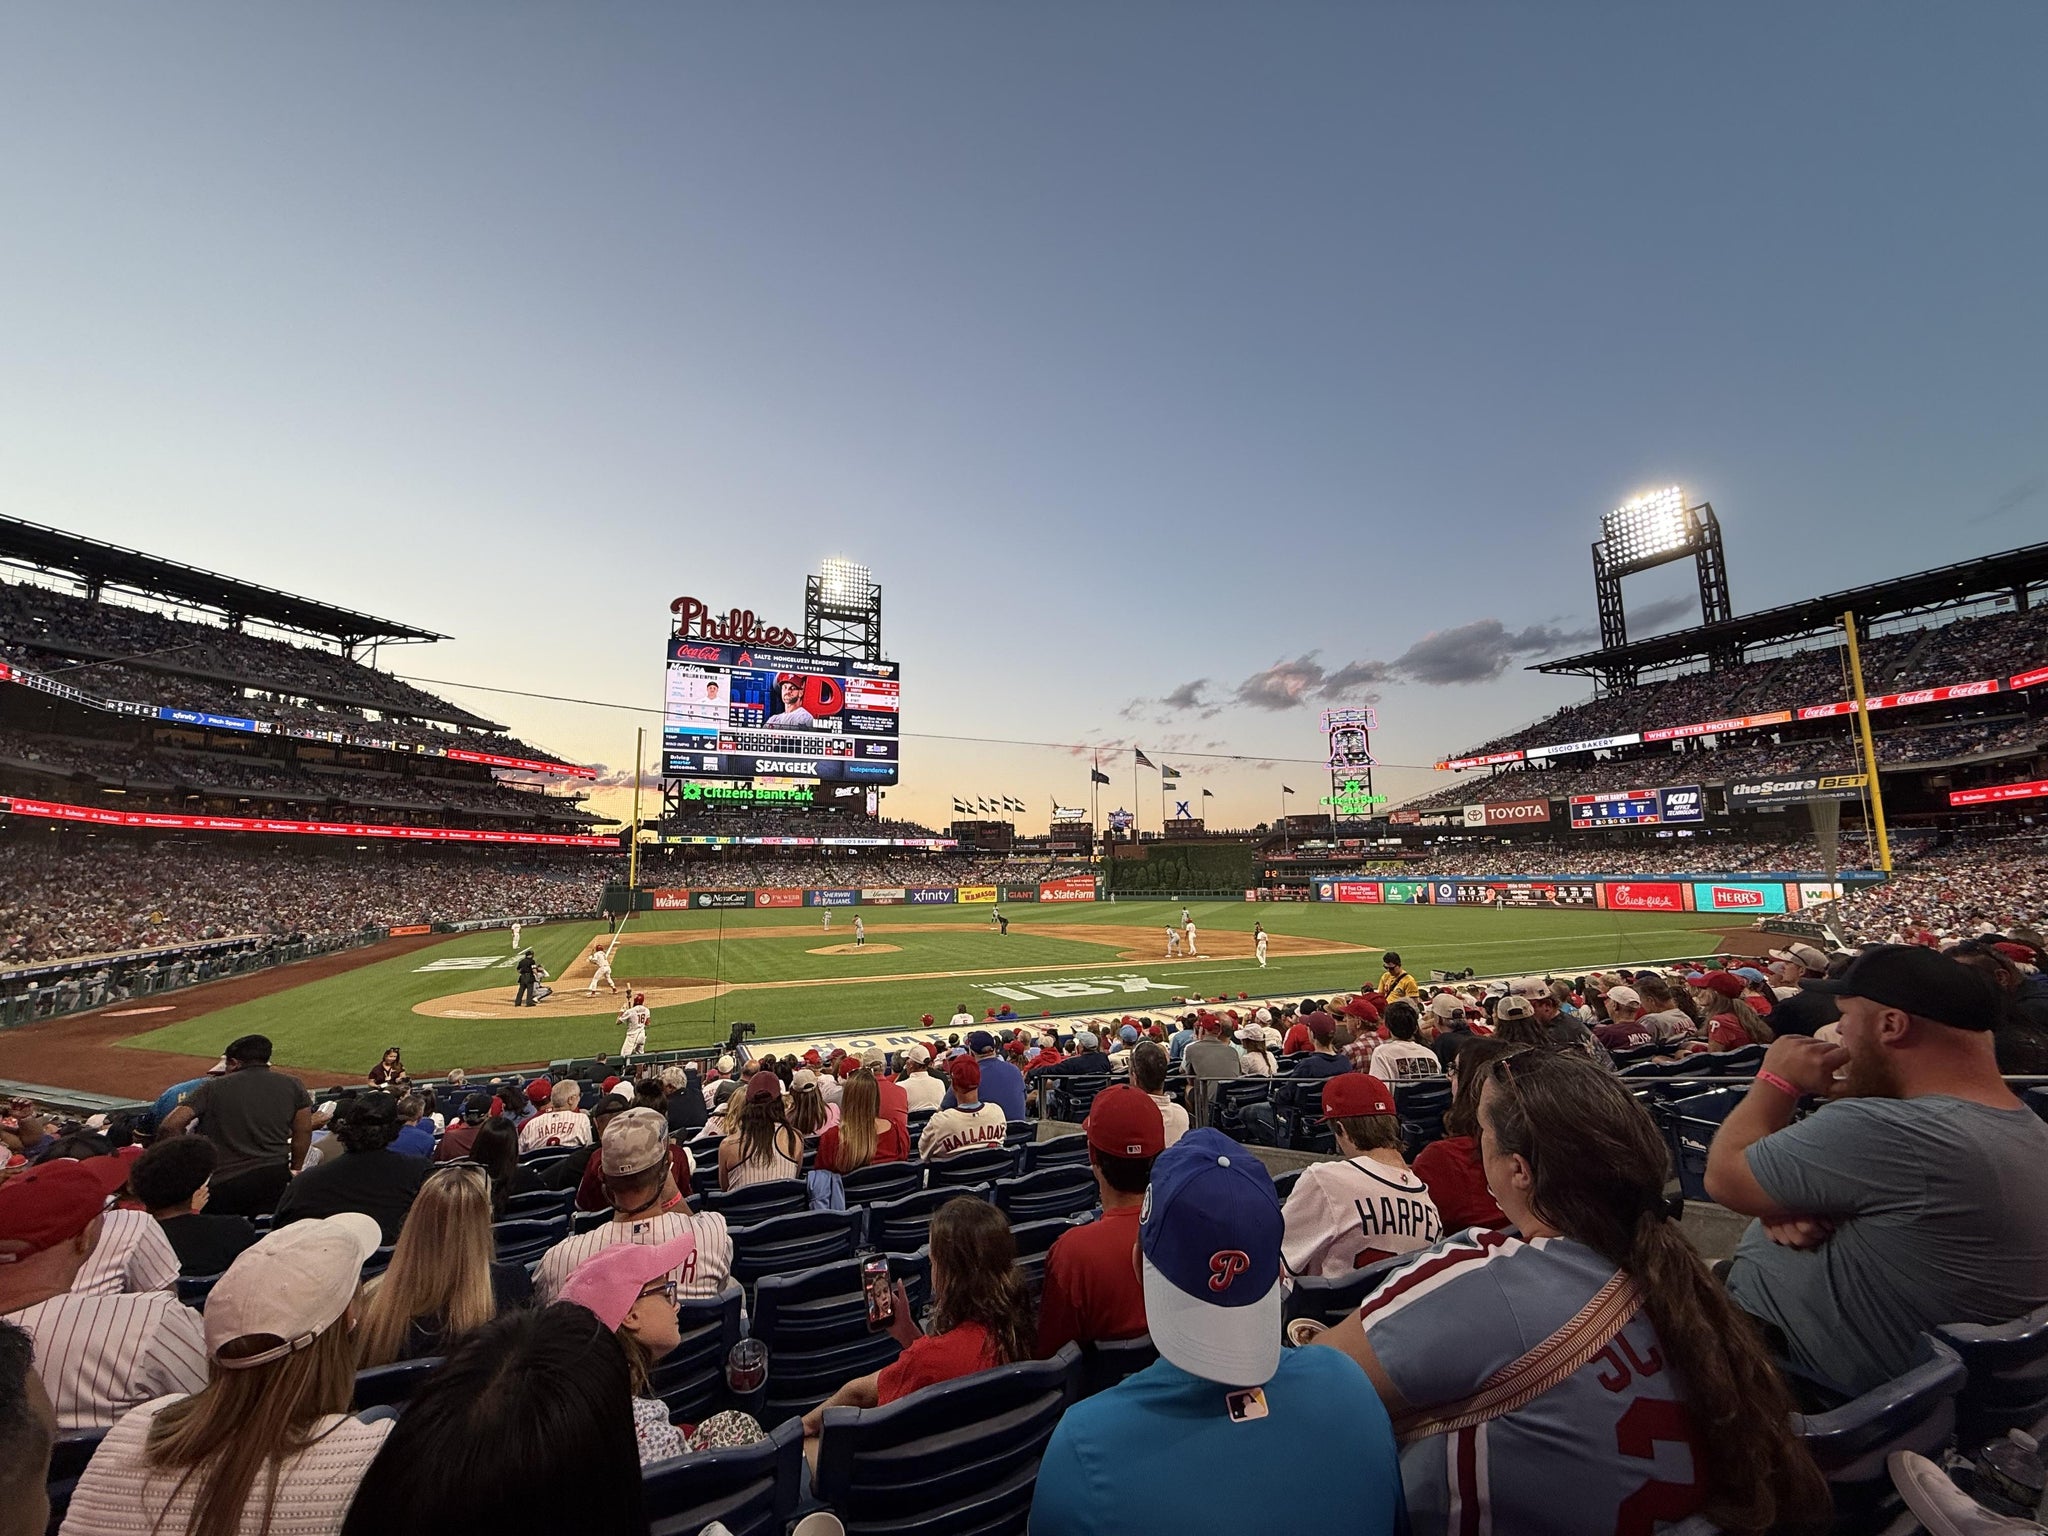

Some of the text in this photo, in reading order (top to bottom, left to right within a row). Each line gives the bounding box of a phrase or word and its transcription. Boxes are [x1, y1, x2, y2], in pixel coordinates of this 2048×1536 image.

[670, 597, 797, 648] Phillies
[669, 663, 706, 673] Marlins
[172, 711, 197, 721] xfinity
[208, 716, 245, 729] Pitch Speed
[812, 718, 843, 729] HARPER
[1648, 720, 1744, 739] WHEY BETTER PROTEIN
[1547, 739, 1614, 754] LISCIO'S BAKERY
[756, 759, 818, 775] SEATGEEK
[1733, 775, 1864, 795] theScore BET
[703, 788, 814, 800] Citizens Bank Park
[1360, 795, 1387, 804] Bank
[1666, 793, 1698, 806] KDI
[1342, 805, 1364, 813] Park
[1487, 805, 1544, 820] TOYOTA
[1666, 808, 1700, 817] TECHNOLOGY
[145, 817, 183, 825] Budweiser
[209, 820, 243, 828] Budweiser
[712, 893, 747, 902] NovaCare
[914, 889, 949, 902] xfinity
[1008, 891, 1034, 899] GIANT
[1614, 891, 1673, 906] Chick-fil-A
[1717, 891, 1758, 905] HERR'S
[655, 897, 688, 908] Wawa
[983, 978, 1190, 1001] IBX
[538, 1121, 575, 1139] HARPER
[942, 1125, 1005, 1152] HALLADAY
[1208, 1249, 1250, 1292] P
